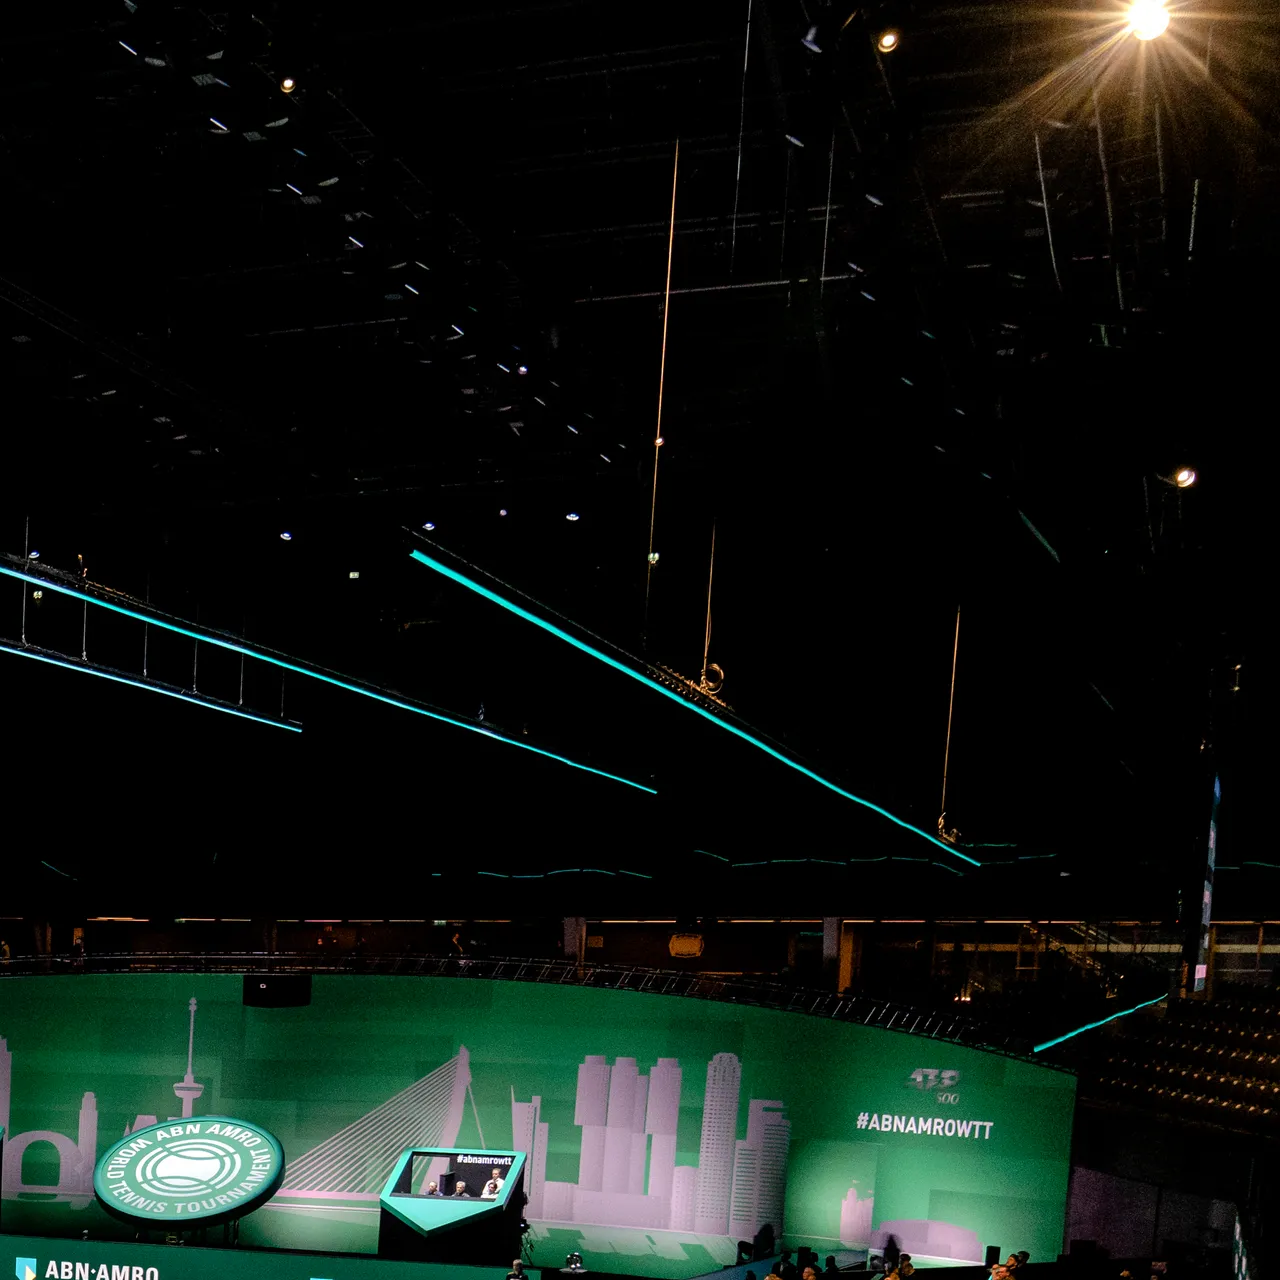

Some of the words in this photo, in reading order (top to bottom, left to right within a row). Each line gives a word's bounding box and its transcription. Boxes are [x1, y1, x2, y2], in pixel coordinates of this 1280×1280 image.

[156, 1123, 201, 1142] ABN
[205, 1123, 262, 1148] AMRO
[856, 1112, 994, 1139] #ABNAMROWTT
[107, 1138, 152, 1179] WORLD
[457, 1154, 512, 1165] #abnamrowtt
[174, 1148, 272, 1214] TOURNAMENT
[109, 1180, 170, 1214] TENNIS
